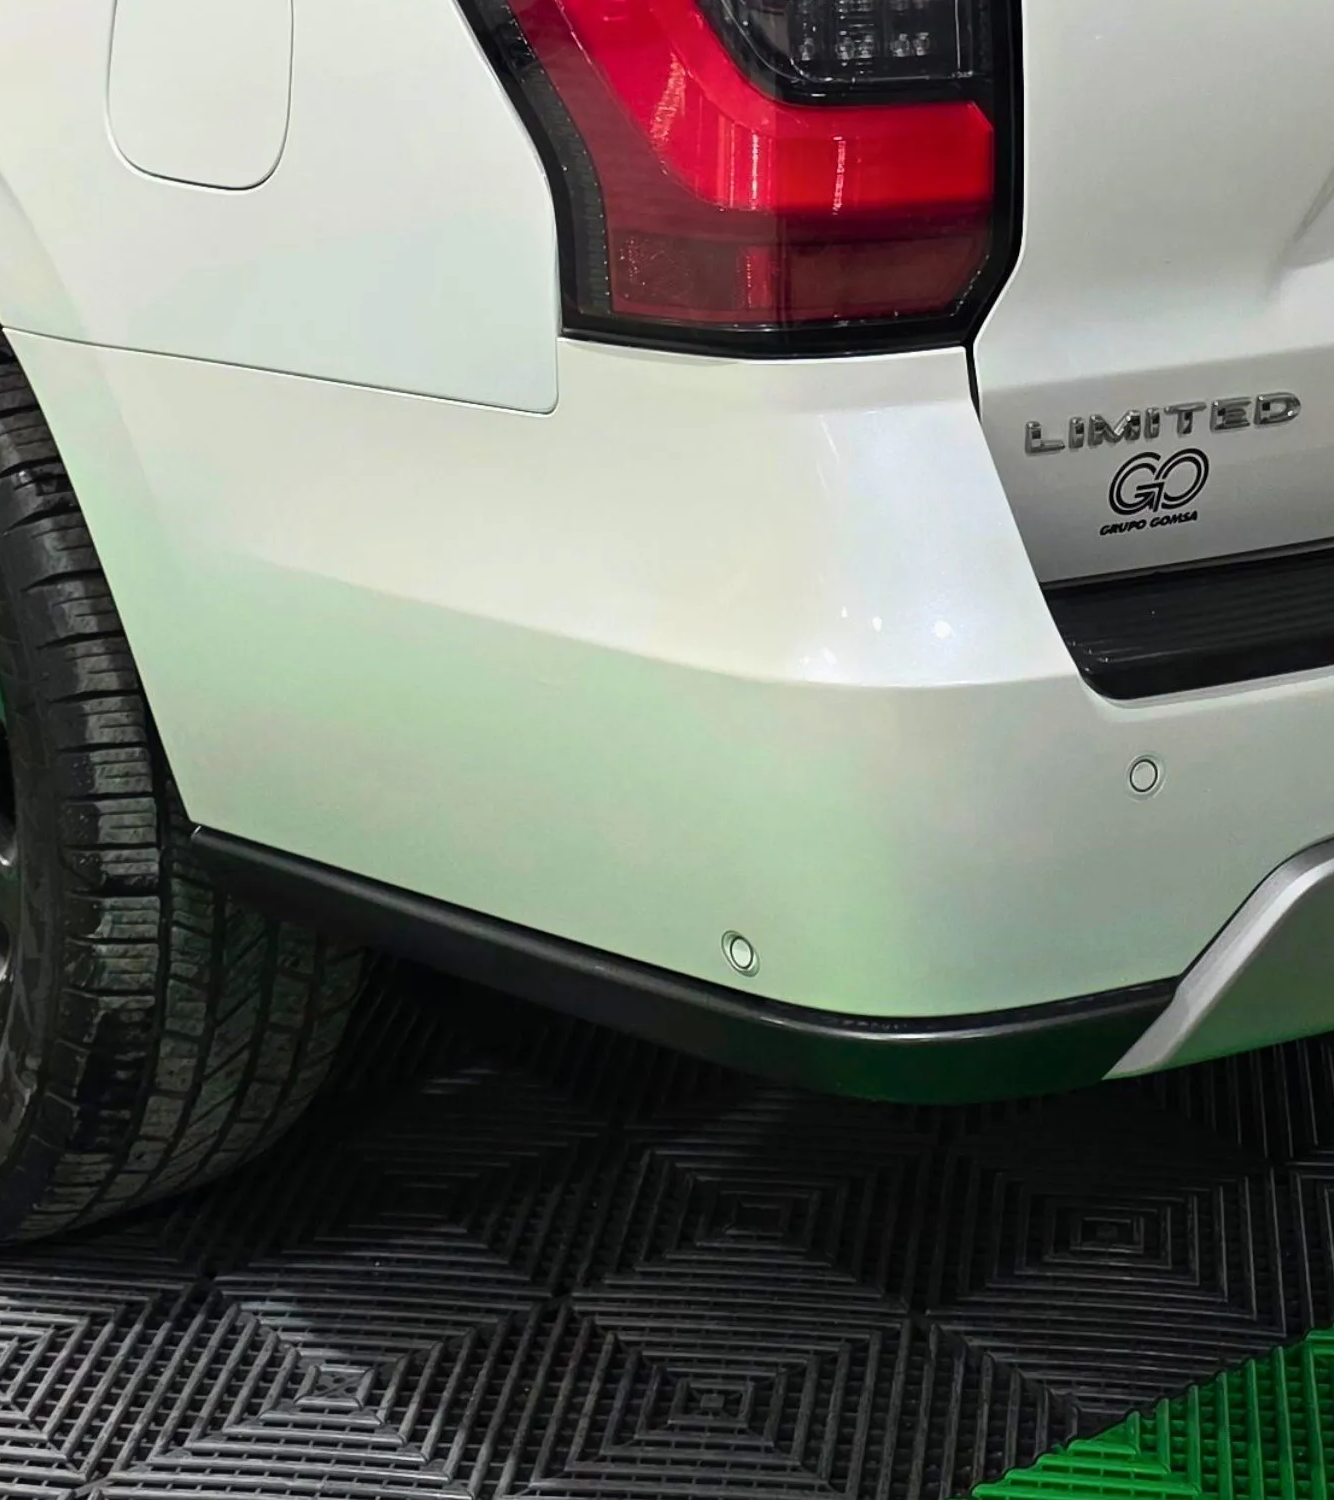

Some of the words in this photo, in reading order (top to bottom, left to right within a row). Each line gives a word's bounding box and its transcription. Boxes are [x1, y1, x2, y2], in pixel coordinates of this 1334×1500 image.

[1023, 392, 1302, 456] LIMITED
[1108, 448, 1210, 516] GO
[1099, 518, 1147, 537] GRUPO
[1149, 510, 1199, 530] GOMSA
